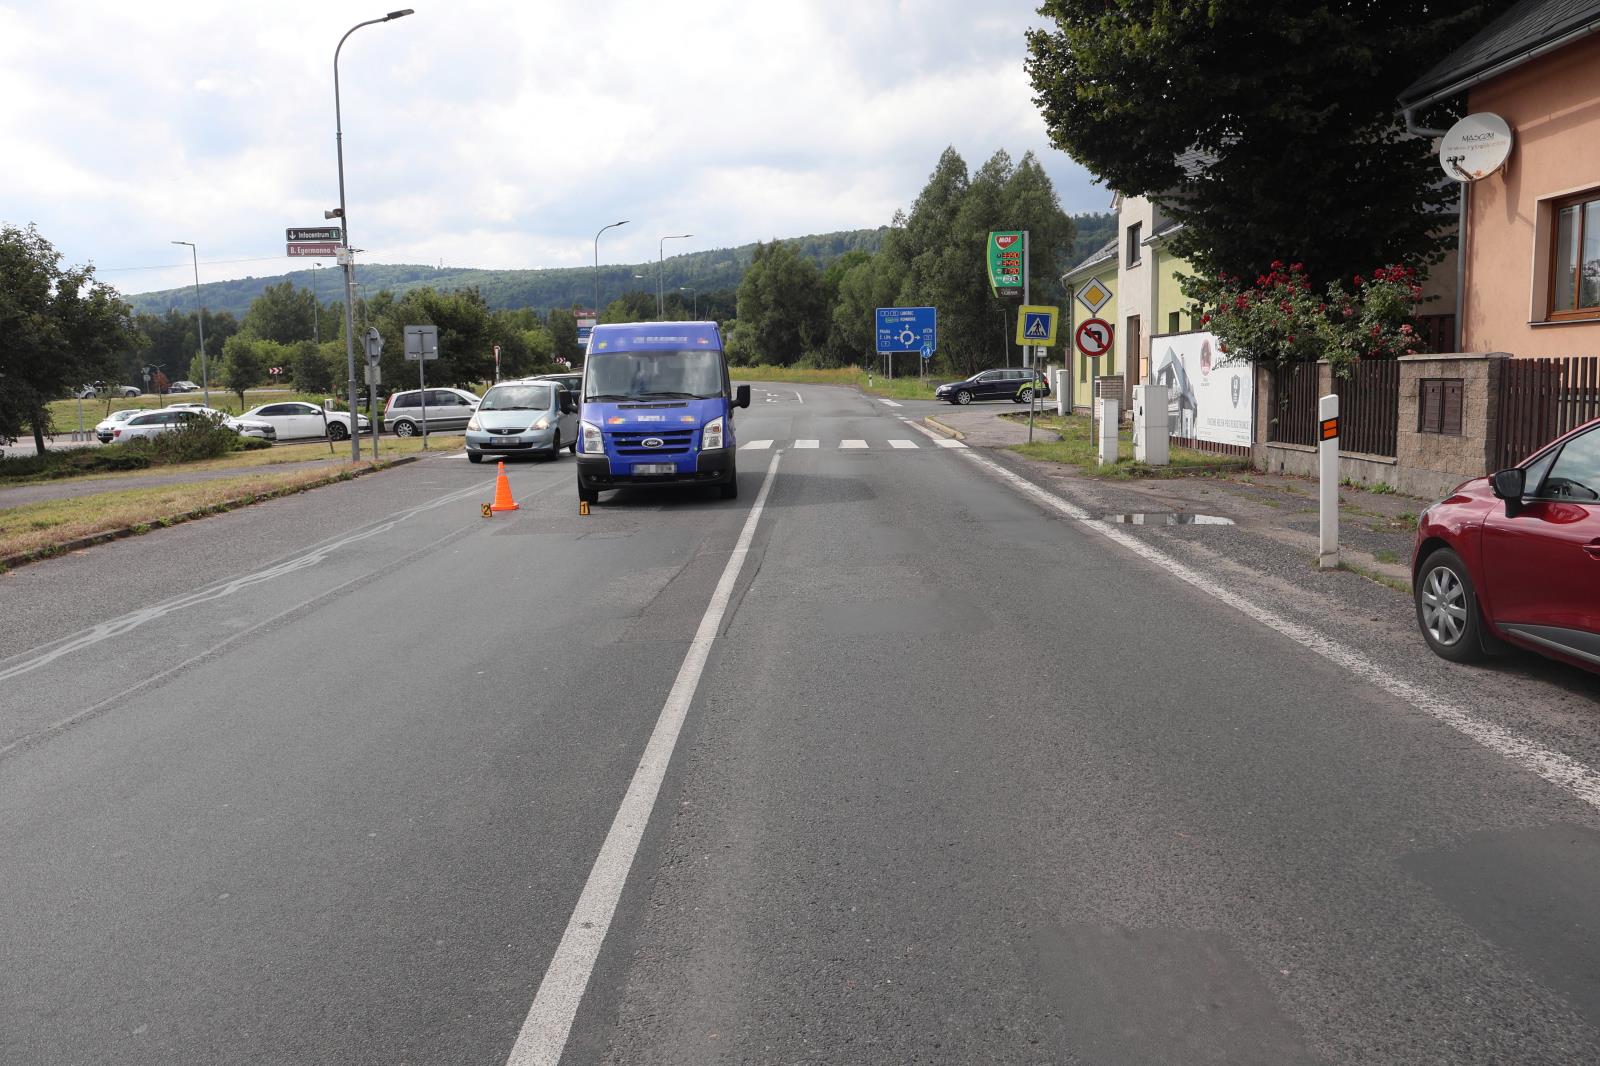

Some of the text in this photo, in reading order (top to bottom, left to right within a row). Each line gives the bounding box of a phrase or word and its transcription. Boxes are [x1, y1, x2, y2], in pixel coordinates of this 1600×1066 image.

[298, 231, 330, 239] Infocentrum
[290, 246, 297, 254] B.
[483, 504, 490, 515] 2
[581, 502, 587, 513] 1
